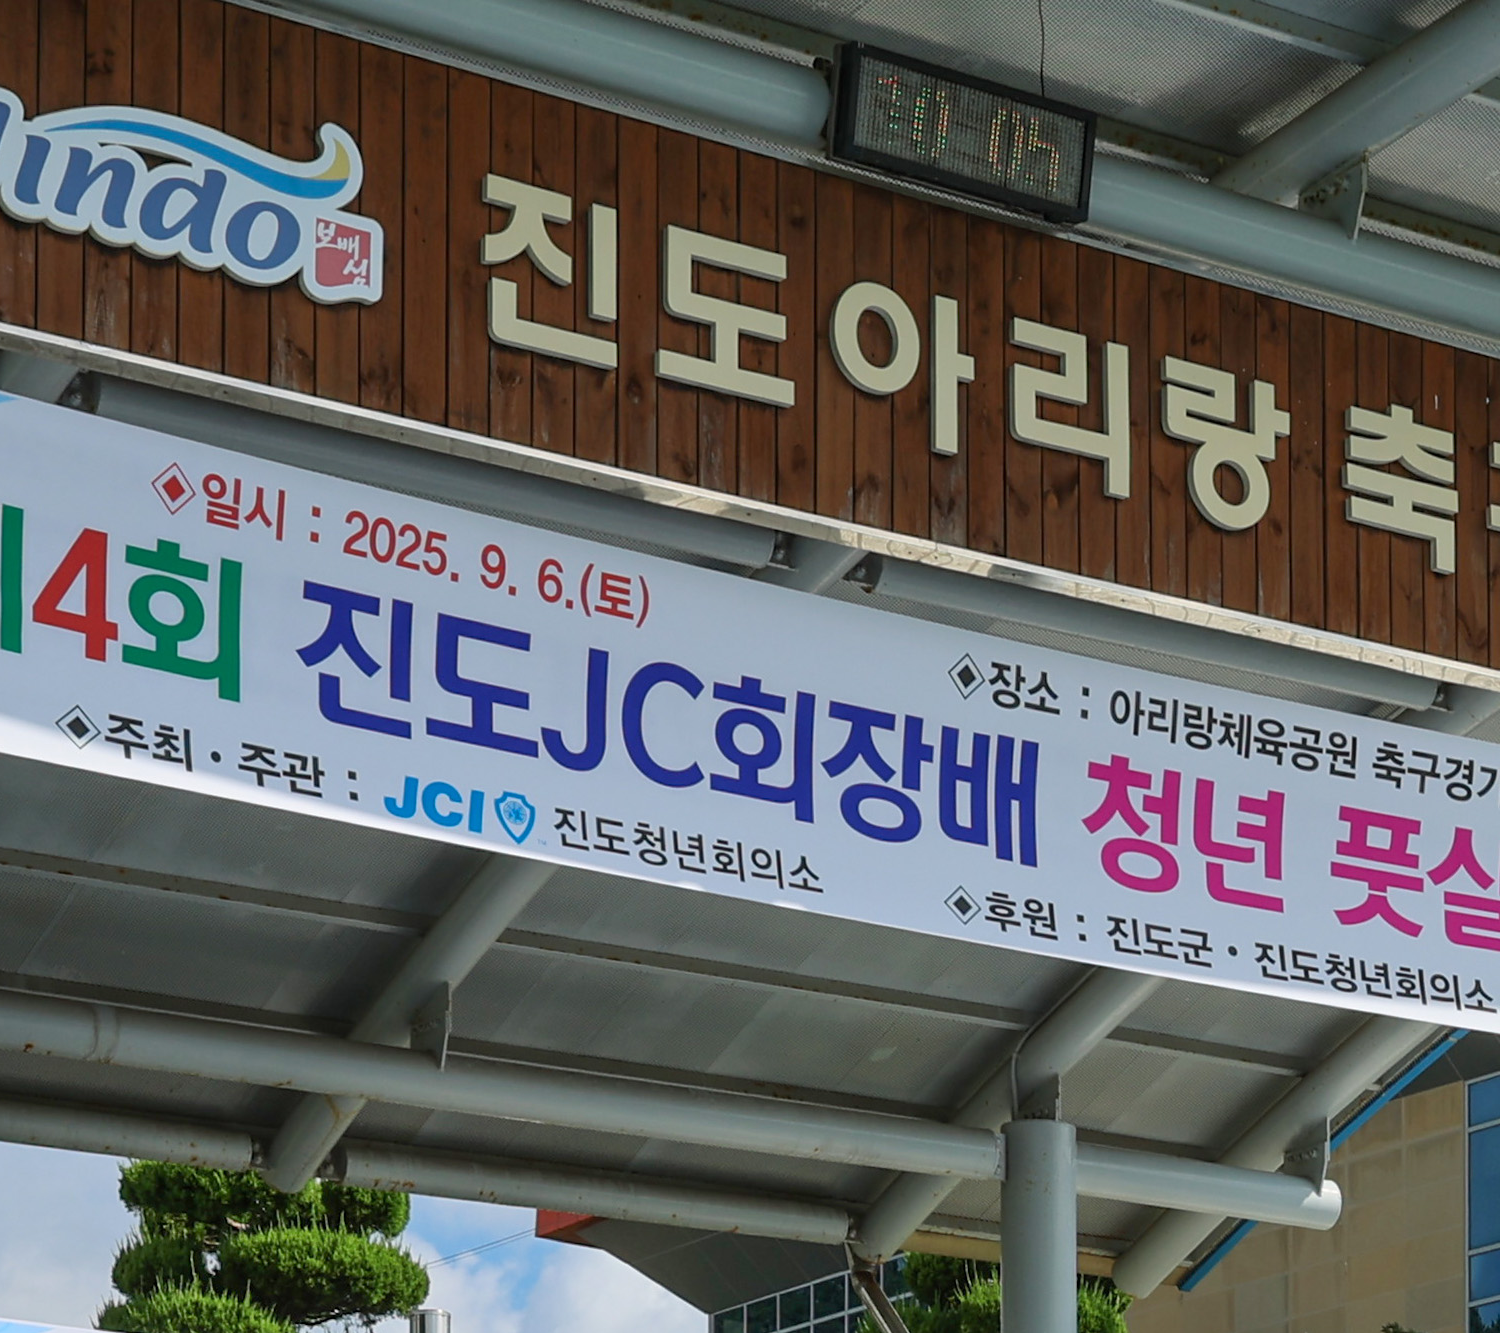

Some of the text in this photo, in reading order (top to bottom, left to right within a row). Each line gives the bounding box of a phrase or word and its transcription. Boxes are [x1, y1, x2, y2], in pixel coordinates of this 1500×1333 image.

[481, 173, 1291, 531] 진도아리랑
[203, 470, 286, 543] 일시
[989, 660, 1061, 716] 장소
[1108, 687, 1360, 779] 아리랑체육공원
[104, 711, 825, 894] 주최 주관 JCI 진도청년회의소
[1080, 753, 1287, 915] 청년
[983, 891, 1058, 943] 후원
[1106, 916, 1215, 969] 진도군
[1252, 941, 1498, 1016] 진도청년회의소
